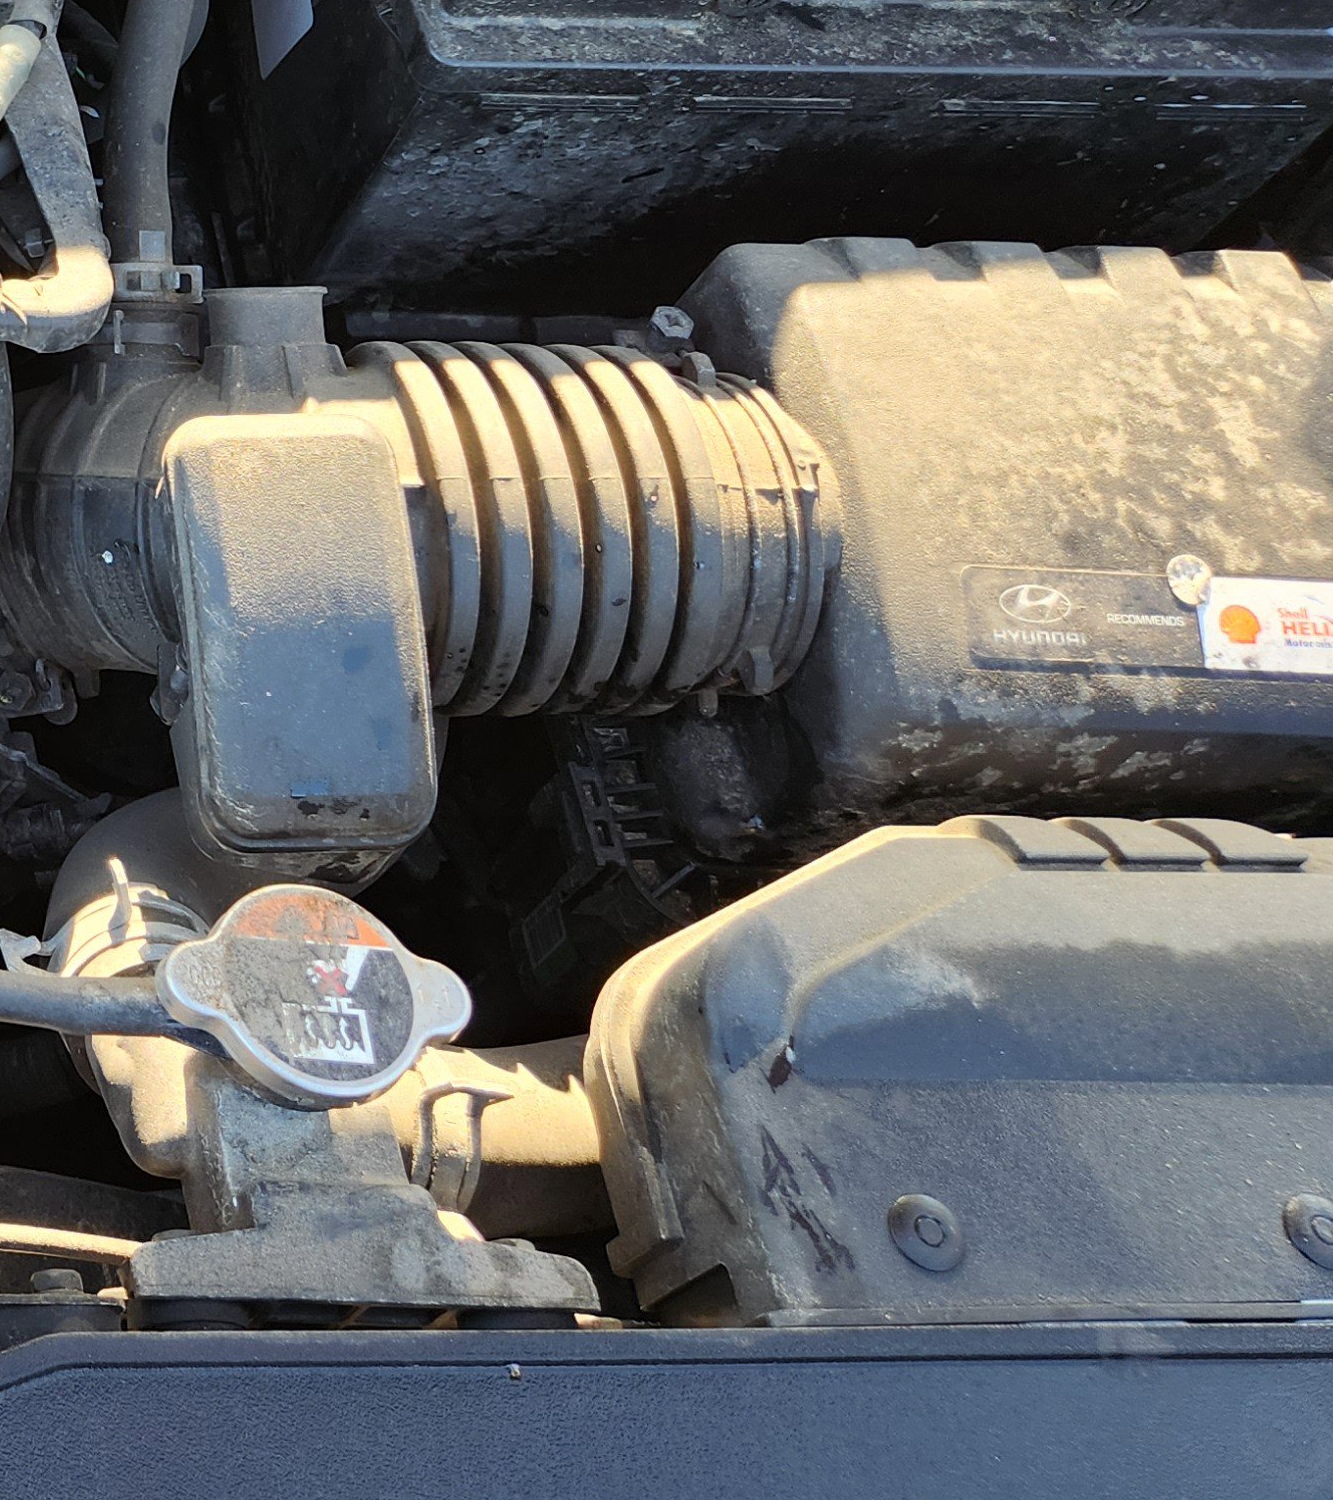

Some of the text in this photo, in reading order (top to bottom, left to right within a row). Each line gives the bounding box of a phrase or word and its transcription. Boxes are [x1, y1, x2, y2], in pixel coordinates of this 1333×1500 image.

[993, 613, 1186, 646] HYUNDAI RECOMMENDS
[1282, 621, 1333, 637] HELI
